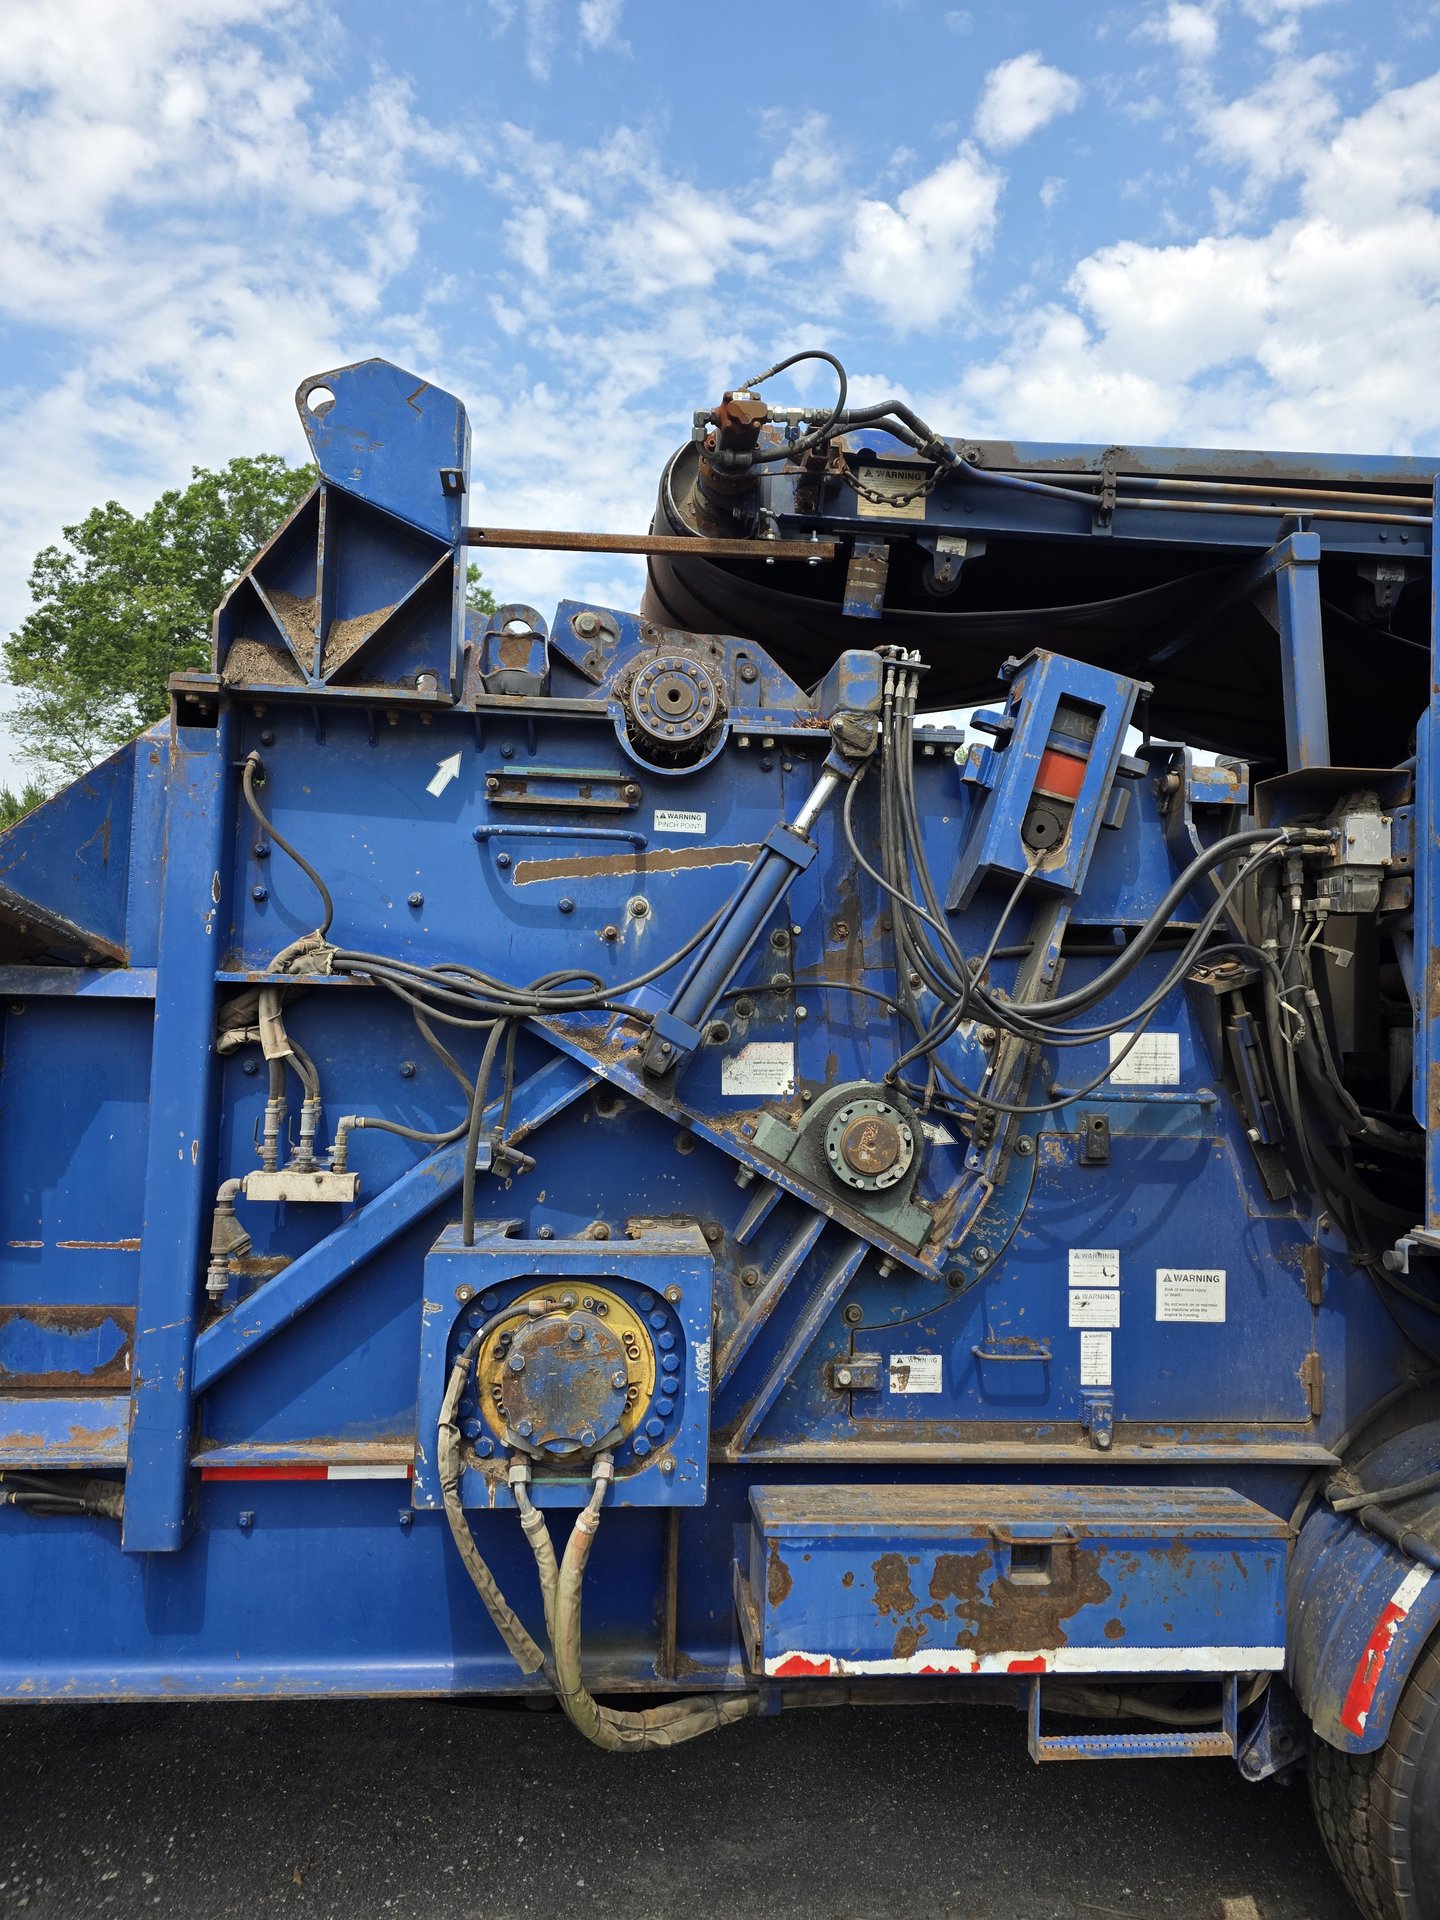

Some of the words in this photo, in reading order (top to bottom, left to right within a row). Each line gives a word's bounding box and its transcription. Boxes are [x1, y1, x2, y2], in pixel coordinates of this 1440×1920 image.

[876, 470, 921, 480] WARNING
[667, 813, 702, 821] WARNING
[1173, 1274, 1220, 1283] WARNING
